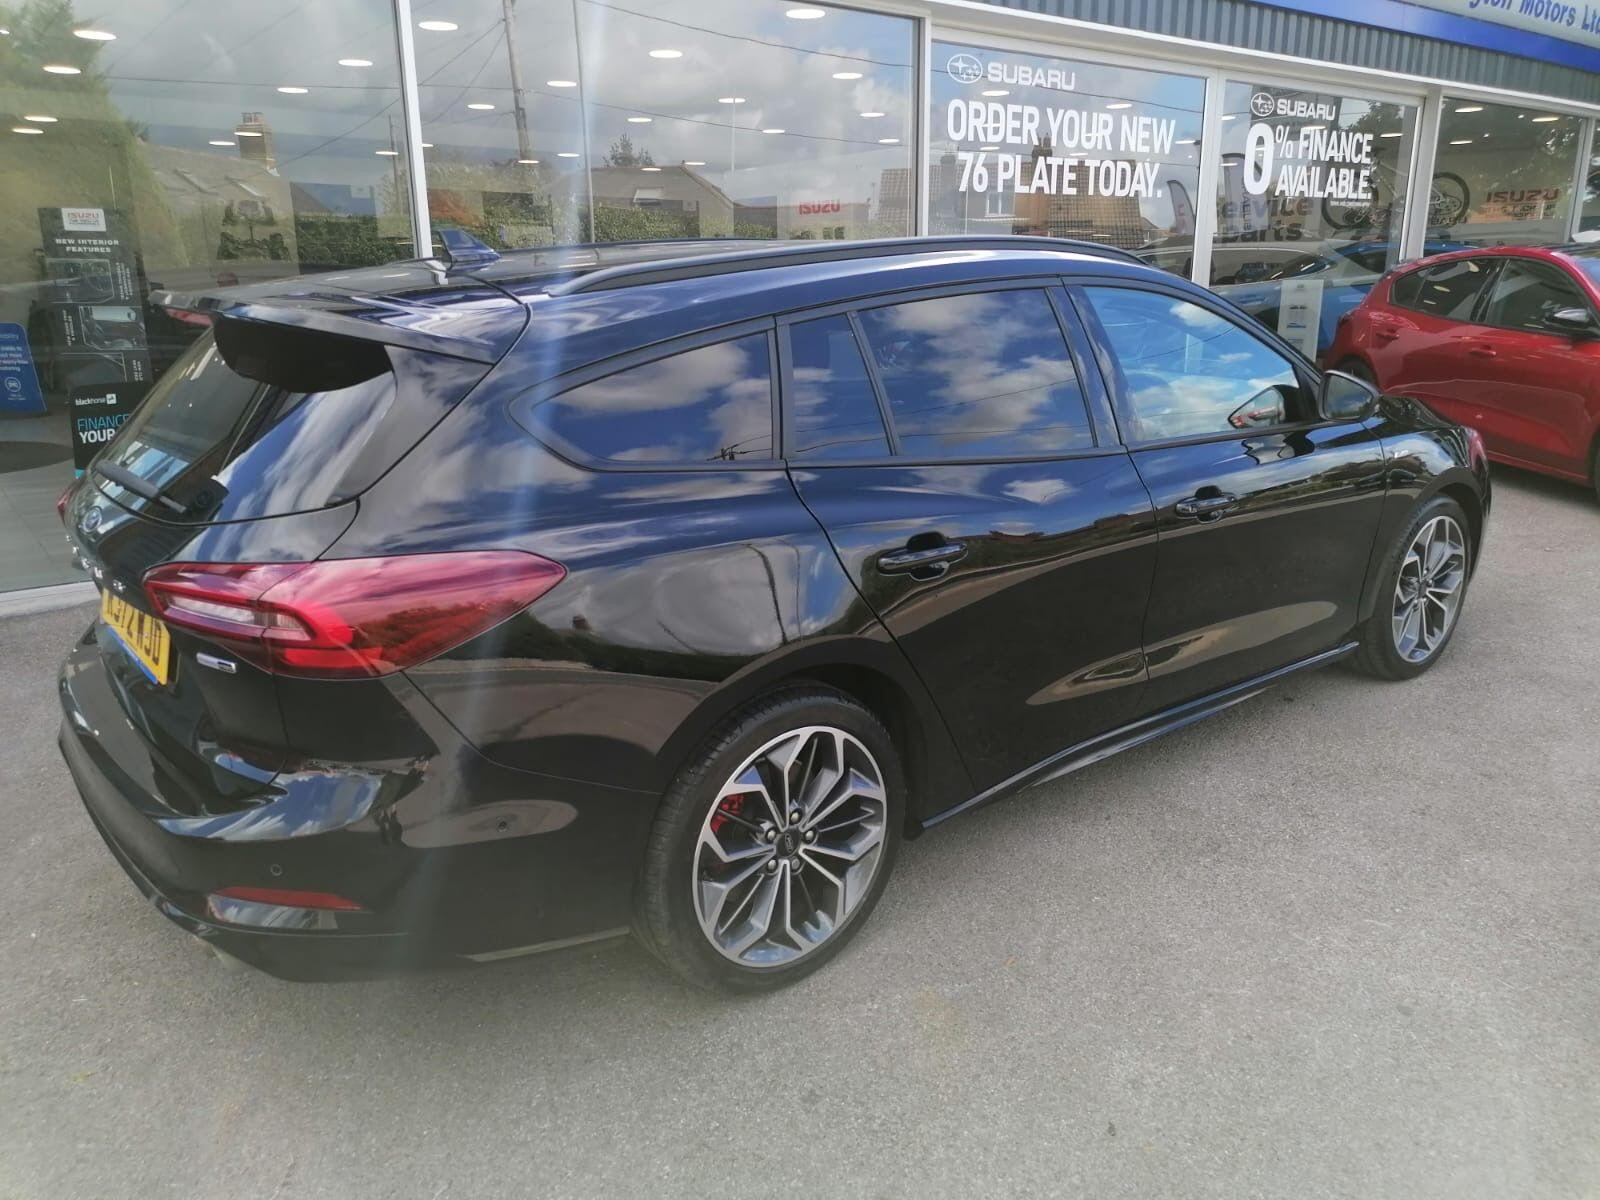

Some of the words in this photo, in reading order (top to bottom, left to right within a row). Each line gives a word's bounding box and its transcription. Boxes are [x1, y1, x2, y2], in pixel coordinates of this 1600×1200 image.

[1519, 0, 1576, 26] Motors
[987, 62, 1076, 90] SUBARU
[1276, 98, 1336, 120] SUBARU
[947, 98, 1040, 146] ORDER
[1047, 107, 1114, 151] YOUR
[1119, 115, 1176, 155] NEW
[1297, 126, 1374, 164] FINANCE
[958, 152, 989, 193] 76
[997, 153, 1077, 196] PLATE
[1087, 159, 1162, 198] TODAY.
[1275, 164, 1372, 200] AVAILABLE.
[799, 201, 841, 215] ISUZU
[1486, 189, 1560, 203] ISUZU
